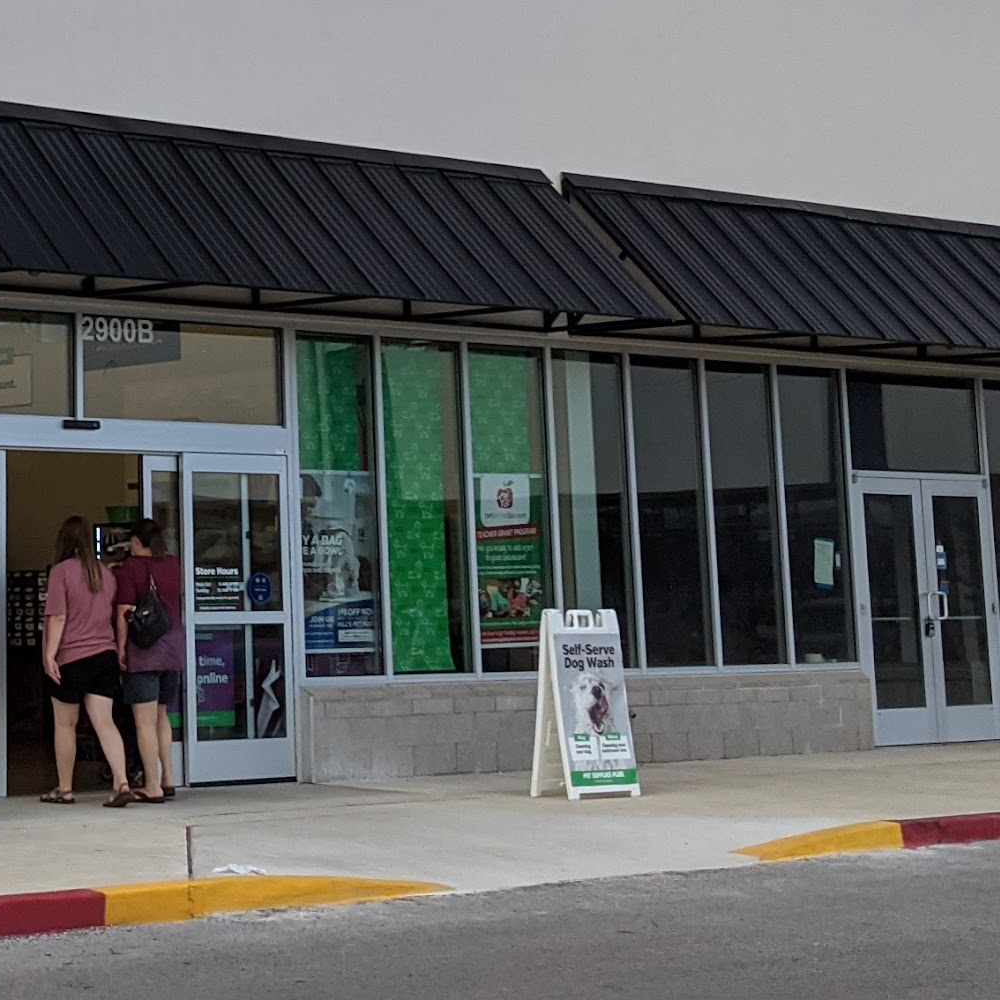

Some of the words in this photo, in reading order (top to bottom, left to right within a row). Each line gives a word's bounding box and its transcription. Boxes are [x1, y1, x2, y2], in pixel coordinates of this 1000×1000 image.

[81, 316, 154, 343] 2900B
[321, 534, 343, 545] BAG
[195, 567, 215, 575] Store
[216, 567, 239, 575] Hours
[562, 643, 615, 656] Self-Serve
[564, 657, 584, 671] Dog
[586, 657, 615, 669] Wash
[196, 672, 229, 684] online
